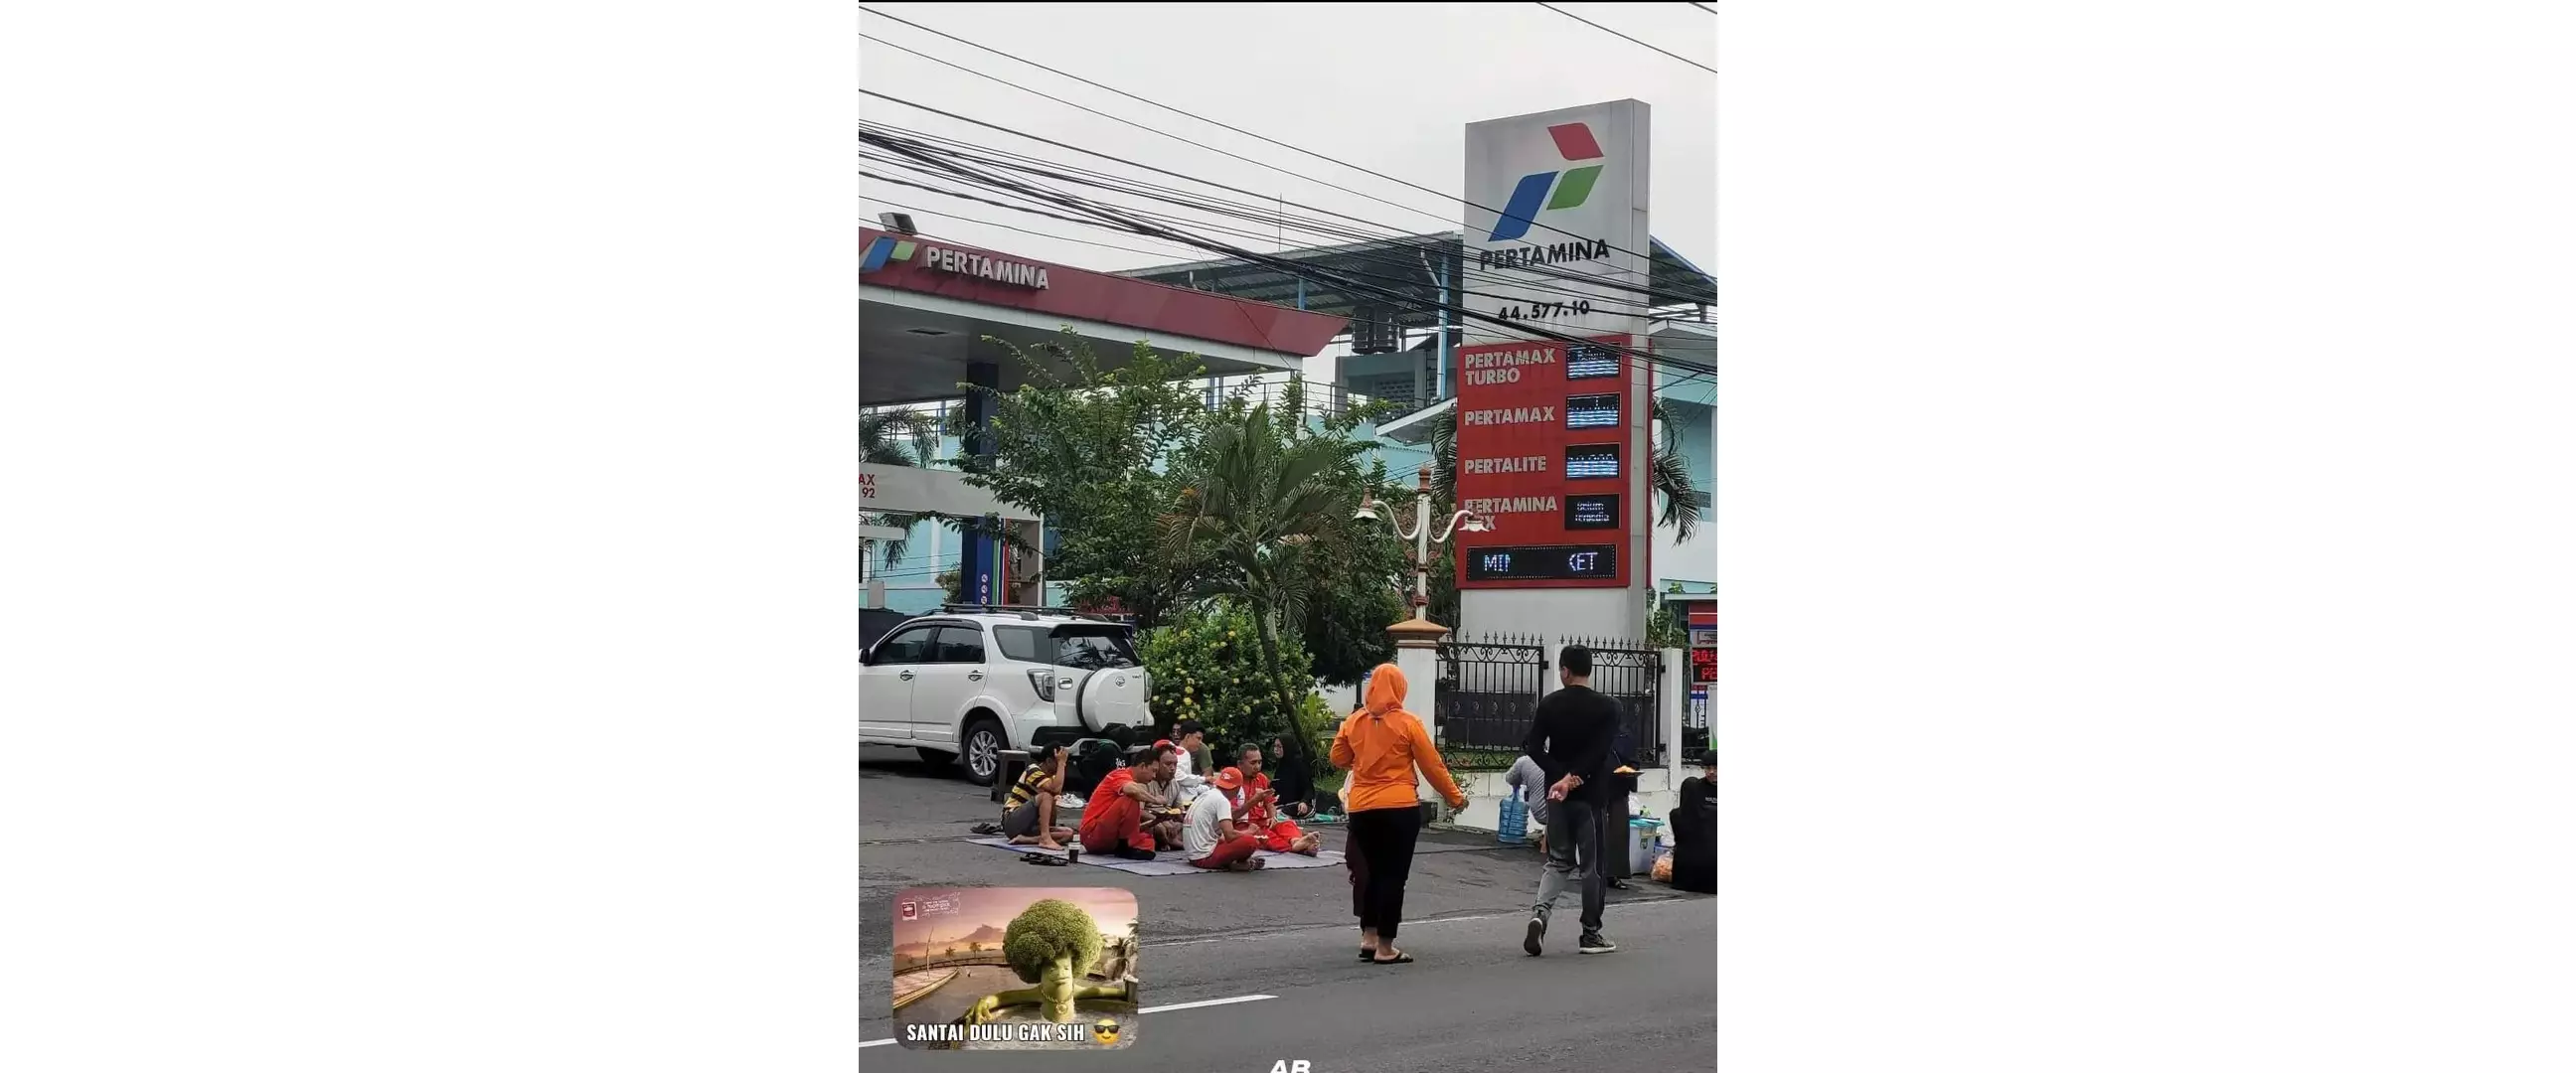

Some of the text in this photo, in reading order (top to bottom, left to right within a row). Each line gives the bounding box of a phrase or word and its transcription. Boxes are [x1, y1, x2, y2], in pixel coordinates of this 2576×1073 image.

[1479, 237, 1610, 271] PERTAMINA
[924, 244, 1049, 290] PERTAMINA
[1498, 299, 1590, 321] 44.577.10
[1464, 348, 1556, 370] PERTAMAX
[1465, 368, 1521, 386] TURBO
[1464, 405, 1555, 426] PERTAMAX
[1464, 455, 1546, 475] PERTALITE
[862, 487, 876, 499] 92
[1464, 495, 1558, 514] PERTAMINA
